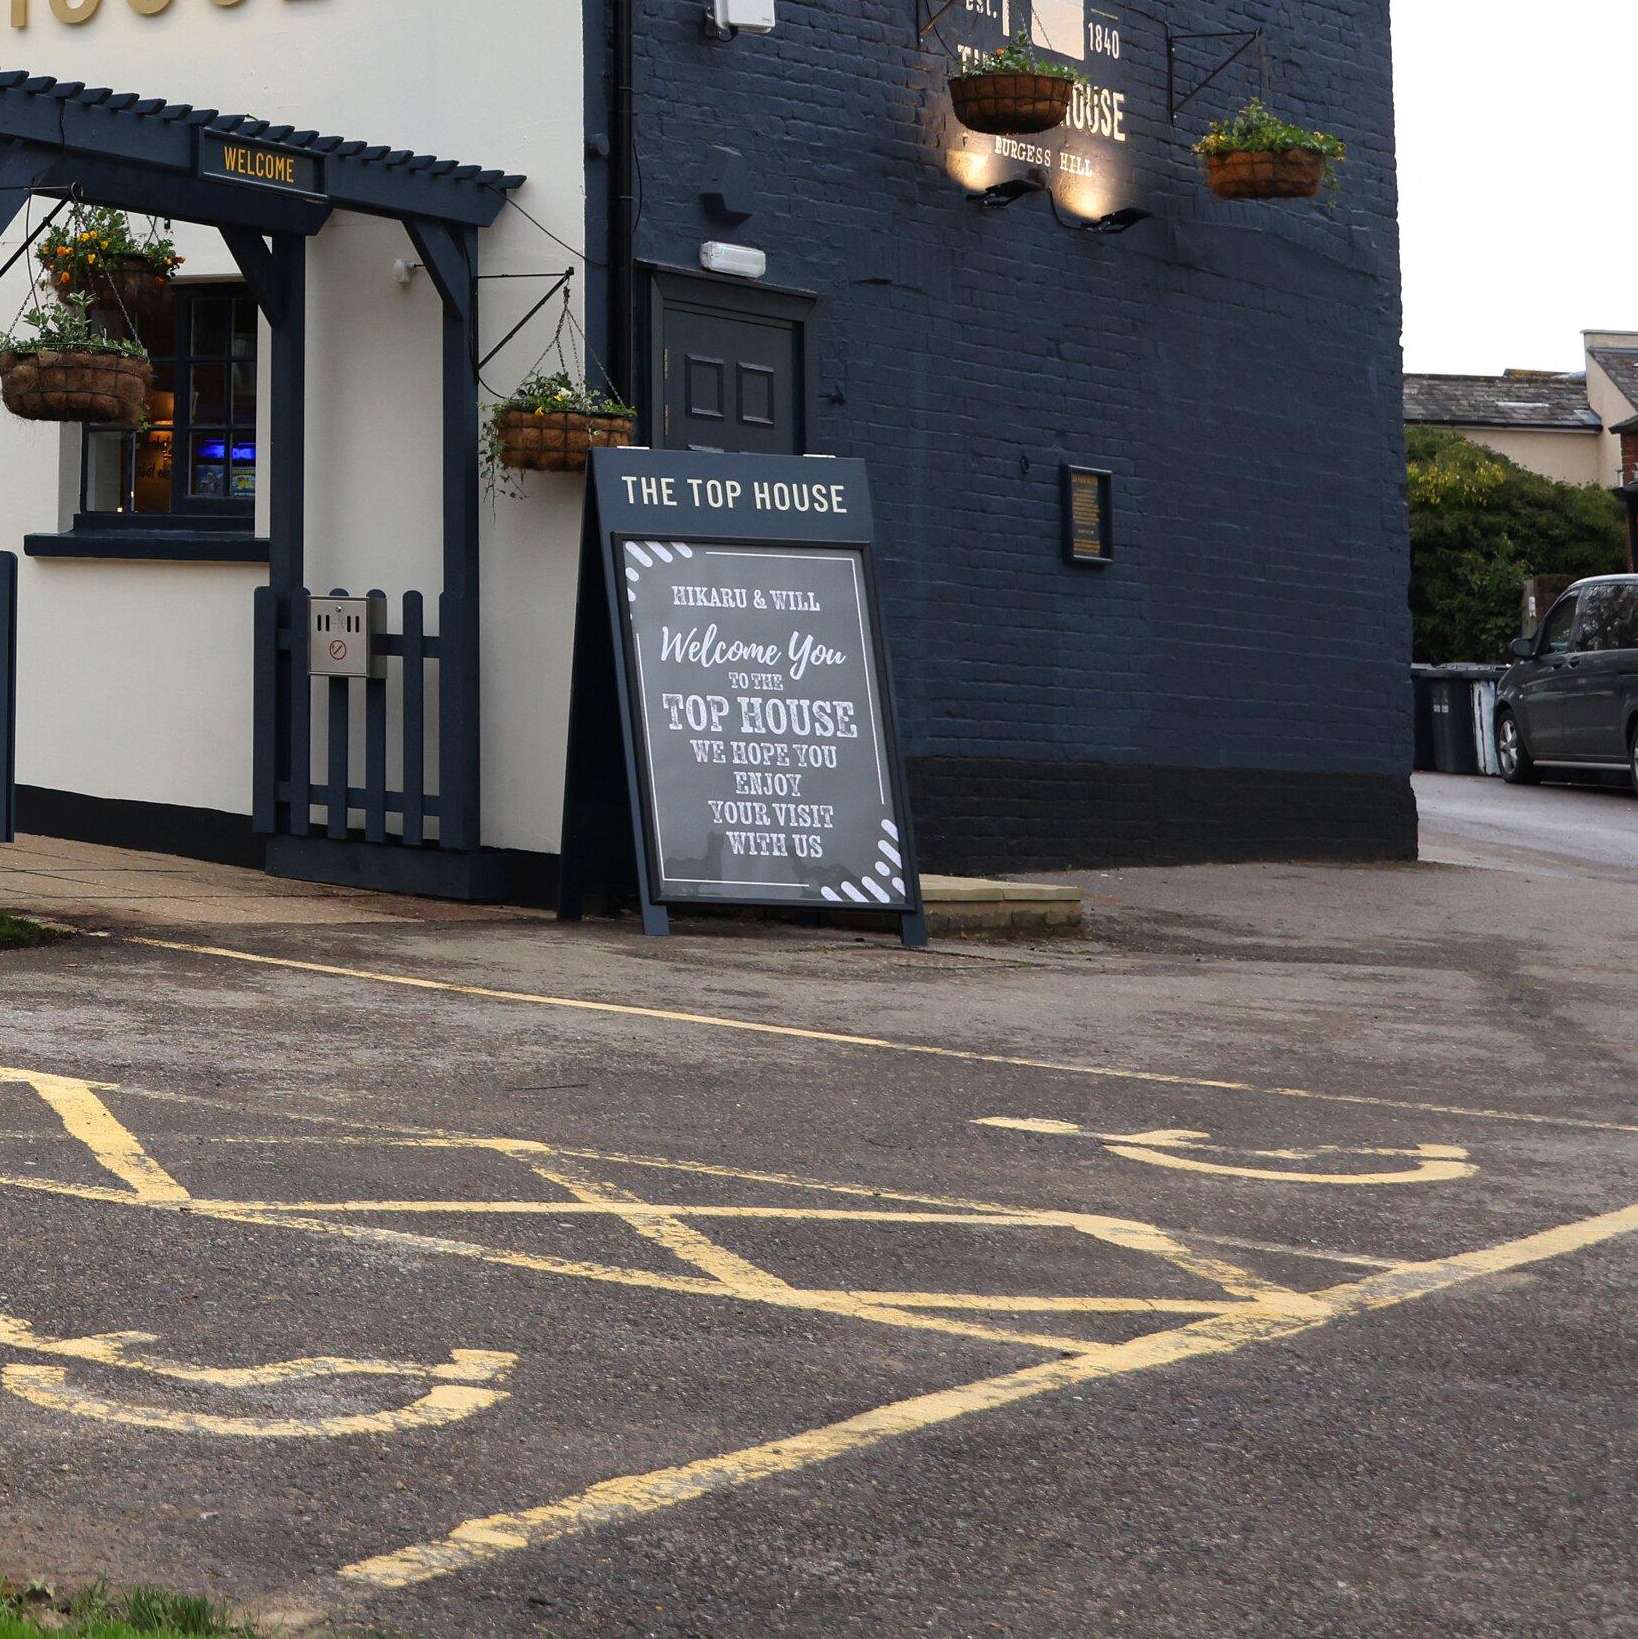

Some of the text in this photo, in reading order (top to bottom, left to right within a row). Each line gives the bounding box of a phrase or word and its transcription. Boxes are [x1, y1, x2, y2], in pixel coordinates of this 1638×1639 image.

[1088, 22, 1120, 60] 1840
[224, 145, 294, 183] WELCOME
[995, 135, 1093, 177] BURGESS HILL
[621, 475, 847, 513] THE TOP HOUSE
[671, 585, 820, 612] HIKARU & WILL
[660, 623, 846, 680] Welcome You
[728, 671, 783, 691] TO THE
[662, 693, 857, 738] TOP HOUSE
[690, 739, 837, 768] WE HOPE YOU
[733, 771, 802, 797] ENJOY
[708, 800, 833, 829] YOUR VISIT
[725, 831, 823, 858] WITH US
